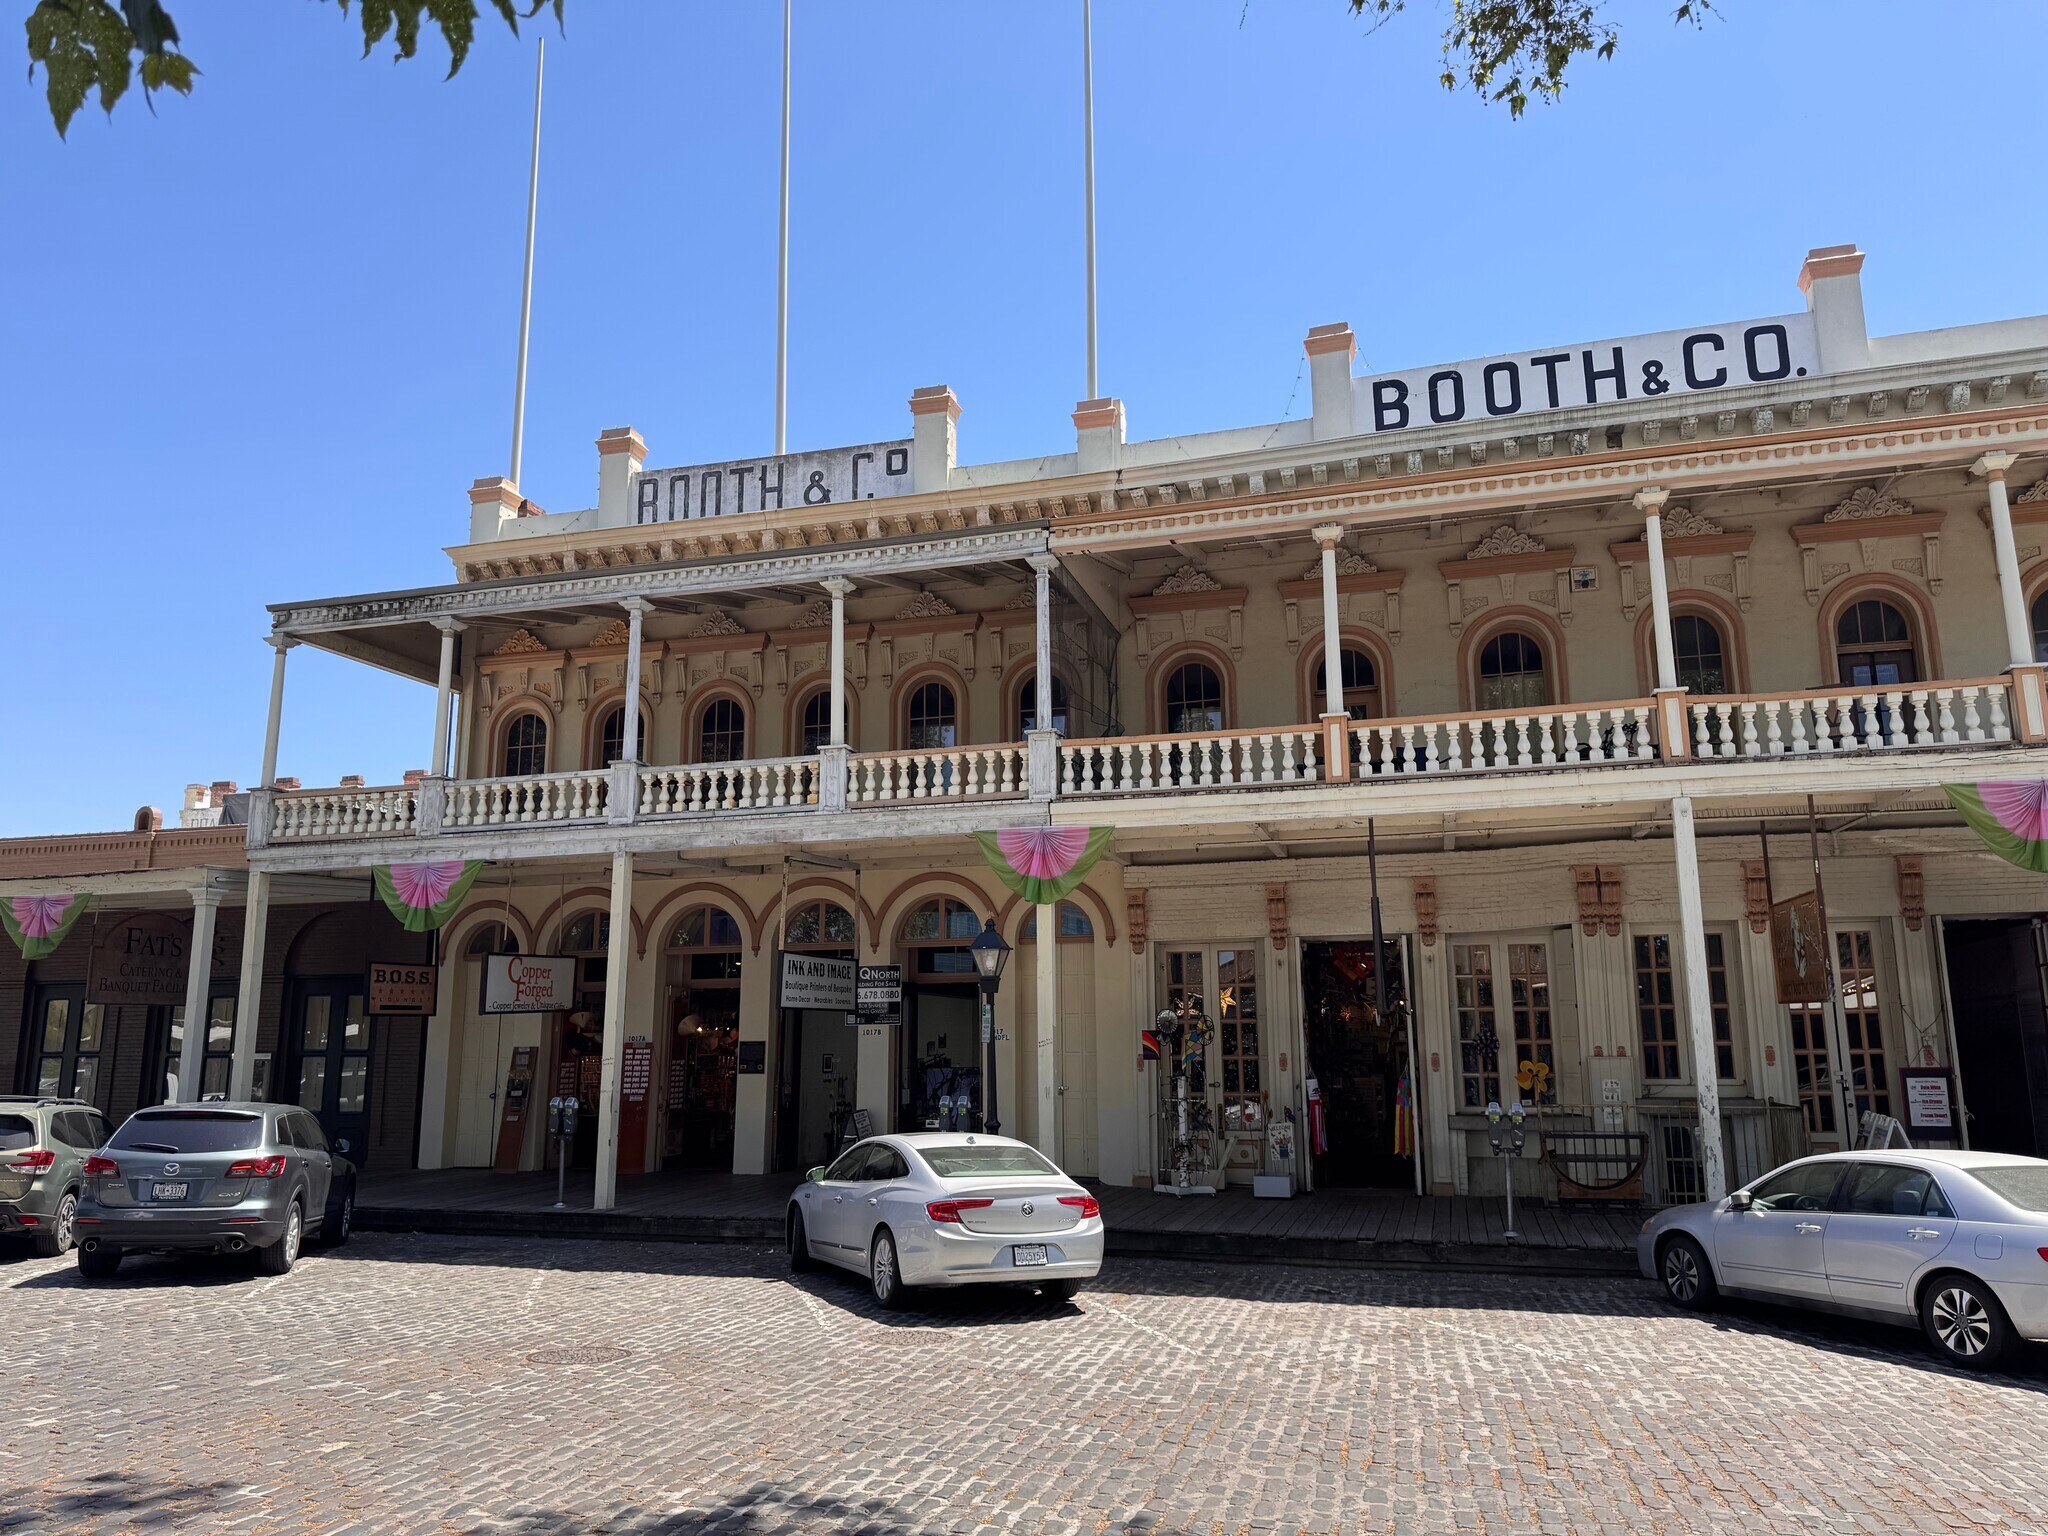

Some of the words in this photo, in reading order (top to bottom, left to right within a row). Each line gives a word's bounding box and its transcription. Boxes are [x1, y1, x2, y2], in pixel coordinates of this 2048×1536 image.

[803, 470, 832, 505] &
[124, 927, 182, 957] FAT'S
[120, 963, 173, 978] CATERING
[175, 970, 182, 978] &
[374, 969, 432, 985] B.O.S.S.
[508, 956, 552, 984] Copper
[788, 960, 805, 976] INK
[807, 962, 825, 977] AND
[827, 964, 852, 980] IMAGE
[100, 977, 150, 994] BANQUET
[513, 980, 553, 1002] Forged
[785, 980, 808, 992] Boutique
[810, 981, 827, 992] Printers
[828, 983, 833, 992] of
[834, 984, 852, 995] Bespoke
[493, 1001, 512, 1010] Copper
[513, 1001, 530, 1011] Jewelry
